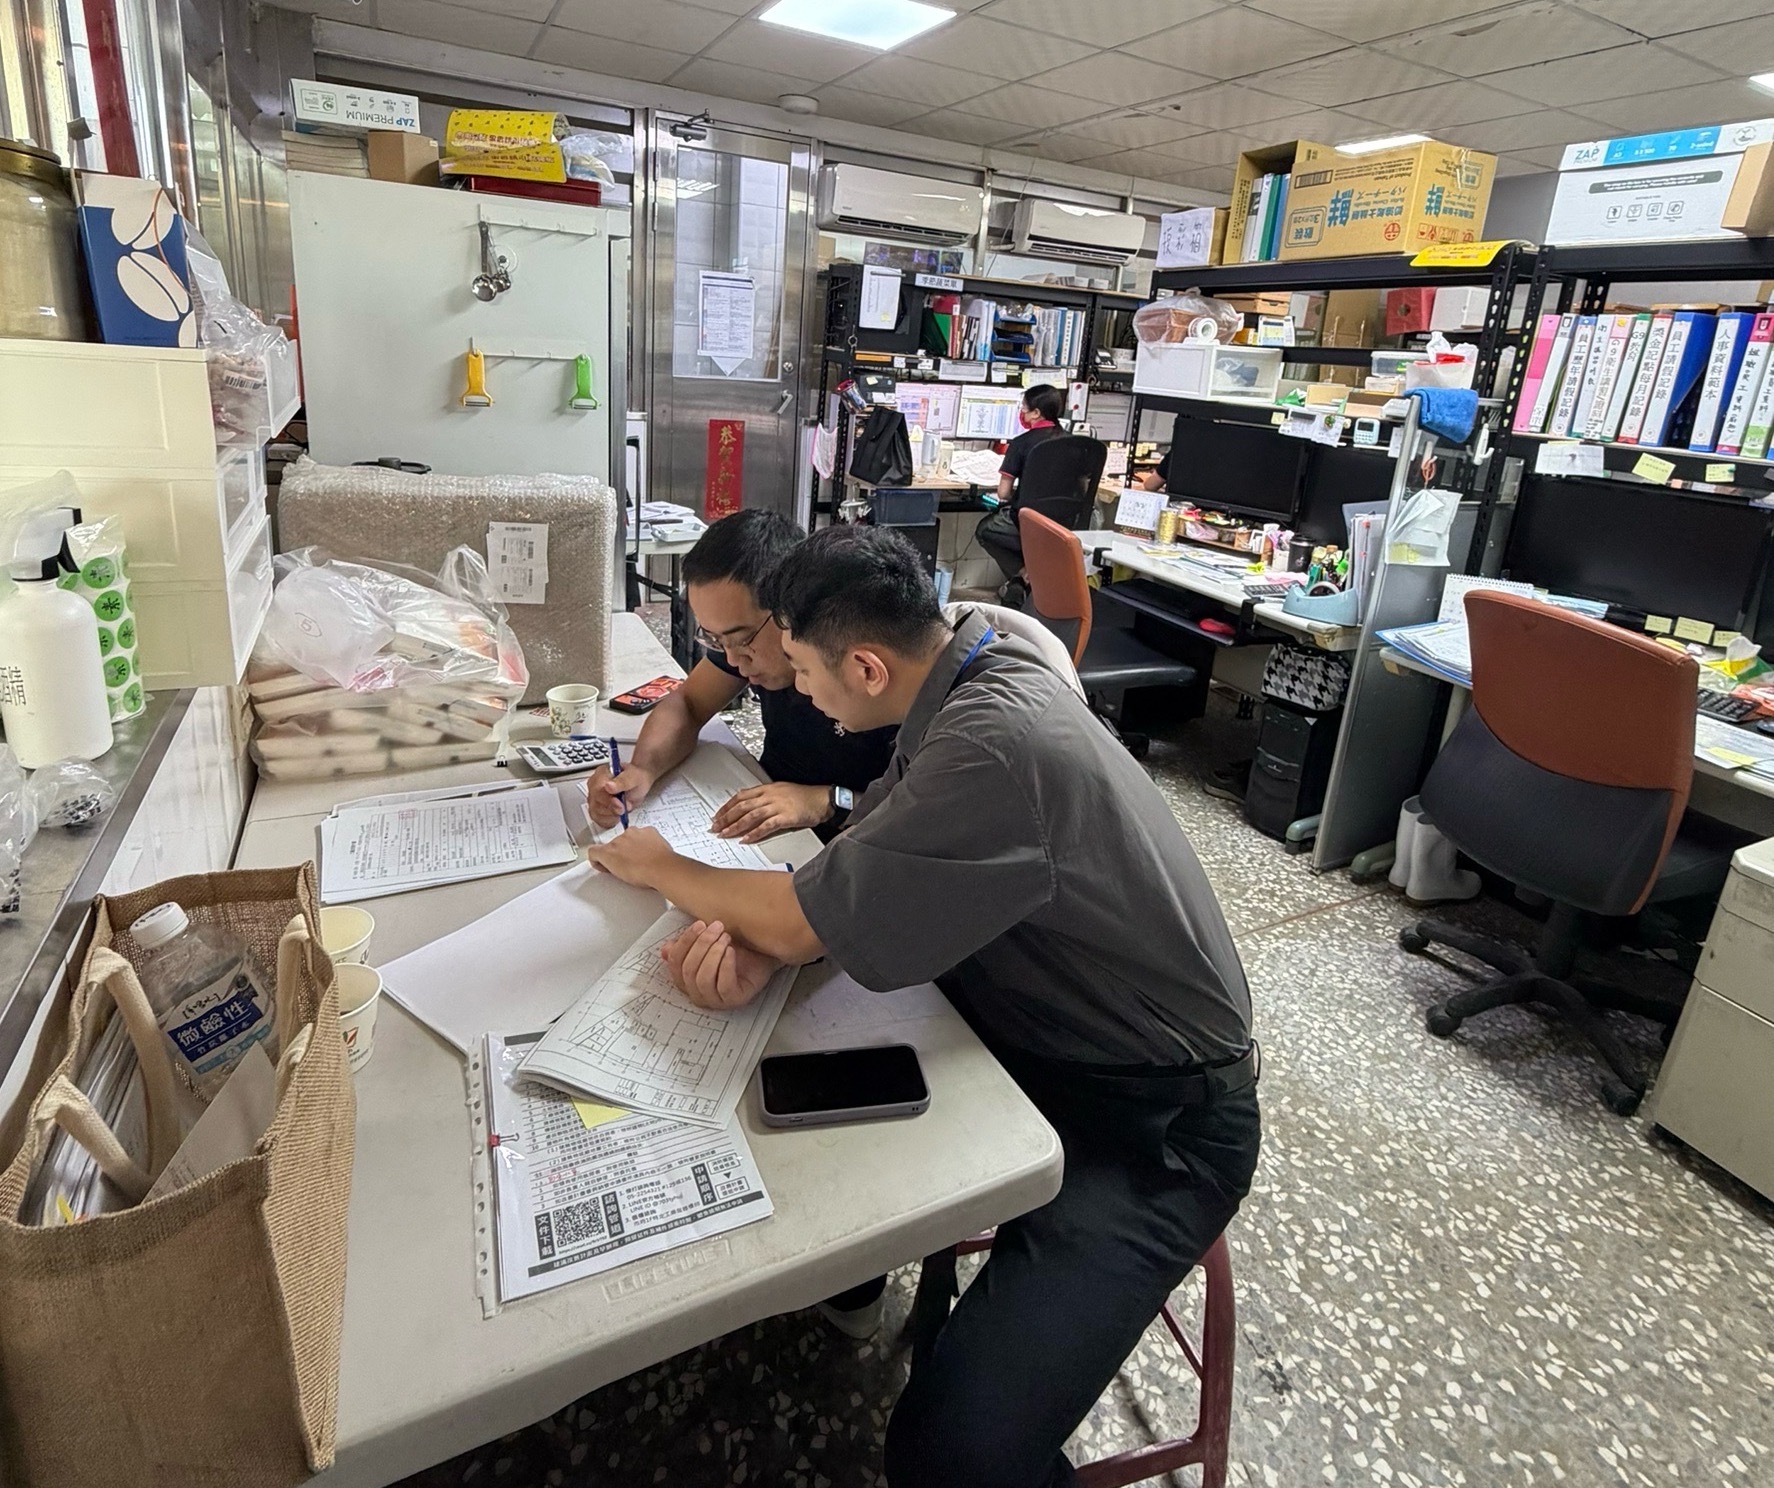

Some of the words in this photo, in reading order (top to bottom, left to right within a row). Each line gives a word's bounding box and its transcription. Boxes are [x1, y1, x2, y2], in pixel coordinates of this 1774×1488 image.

[346, 110, 393, 124] PREMIUM
[396, 118, 415, 127] ZAP
[1576, 149, 1600, 159] ZAP
[176, 1000, 250, 1048] 微鹼性
[693, 1165, 714, 1203] 申請順序
[602, 1194, 621, 1234] 諮詢管道
[537, 1216, 554, 1256] 文件下載
